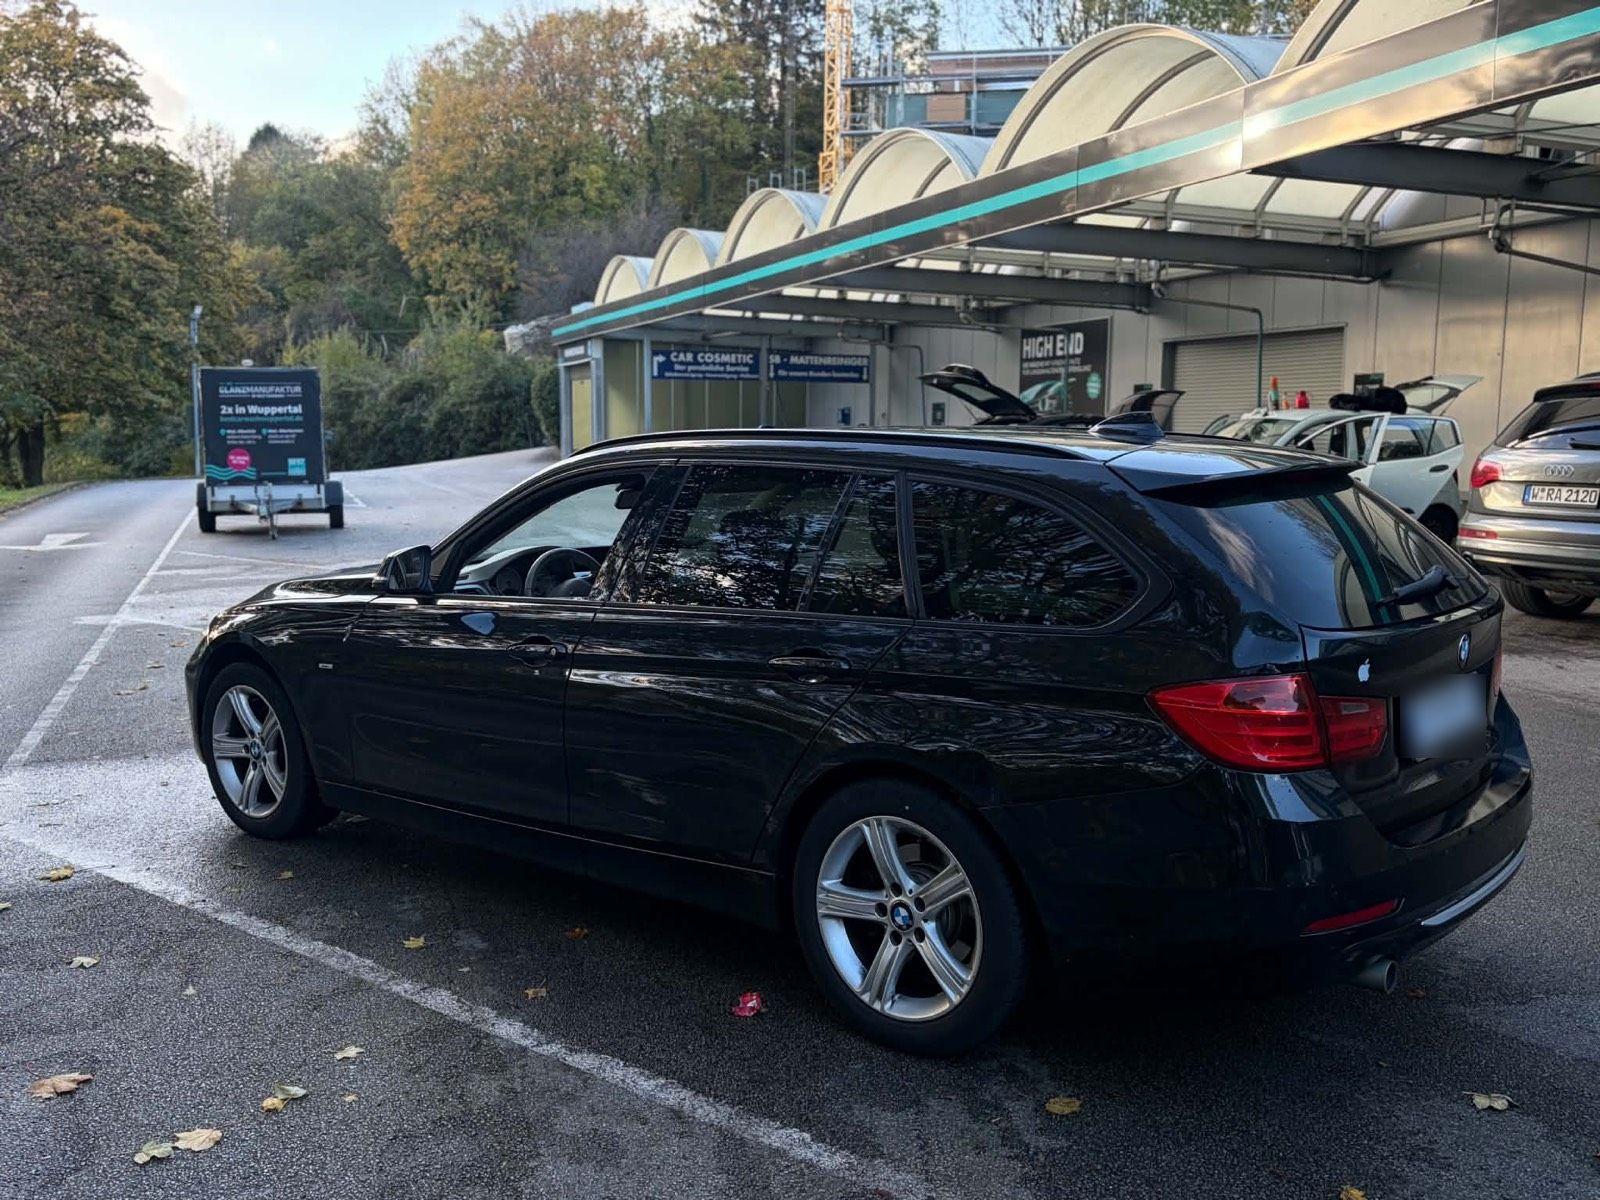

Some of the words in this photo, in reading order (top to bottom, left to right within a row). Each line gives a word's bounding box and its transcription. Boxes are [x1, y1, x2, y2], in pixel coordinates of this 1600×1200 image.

[1022, 335, 1054, 359] HIGH
[670, 351, 694, 362] CAR
[697, 352, 754, 364] COSMETIC
[769, 354, 781, 364] SB
[789, 354, 868, 367] MATTENREINIGER
[220, 404, 234, 415] 2x
[235, 404, 246, 415] in
[247, 404, 303, 416] Wuppertal
[1564, 489, 1599, 504] 2120
